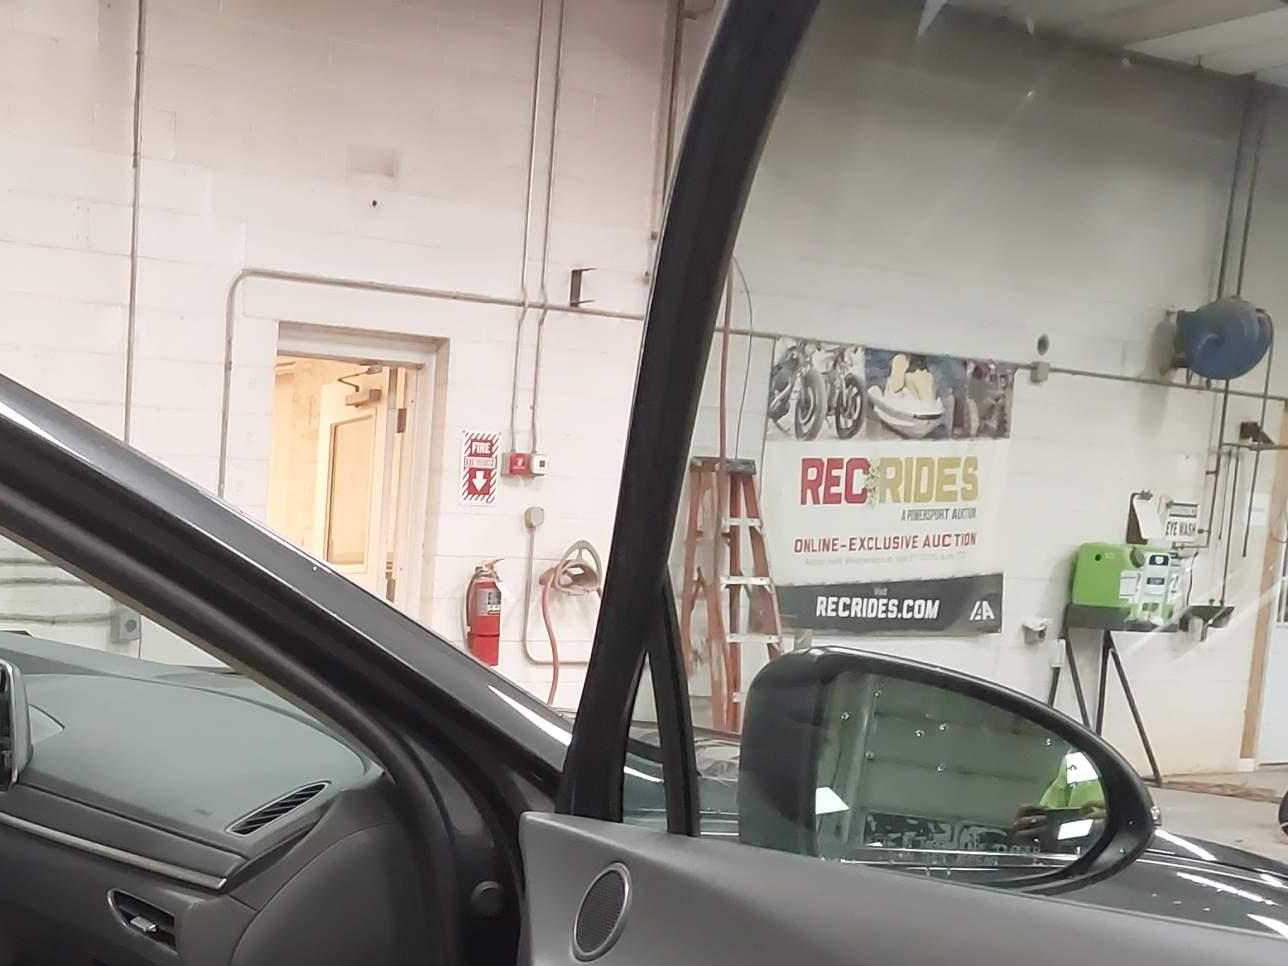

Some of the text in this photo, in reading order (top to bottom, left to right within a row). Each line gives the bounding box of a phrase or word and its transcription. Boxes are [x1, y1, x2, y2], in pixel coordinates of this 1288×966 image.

[471, 442, 491, 454] FIRE
[901, 509, 906, 521] A
[907, 508, 950, 521] POWERSPORT
[1165, 521, 1197, 537] EYE WASH
[794, 532, 977, 553] ONLINE-EXCLUSIVE AUCTION
[816, 596, 940, 620] RECRIDES.COM
